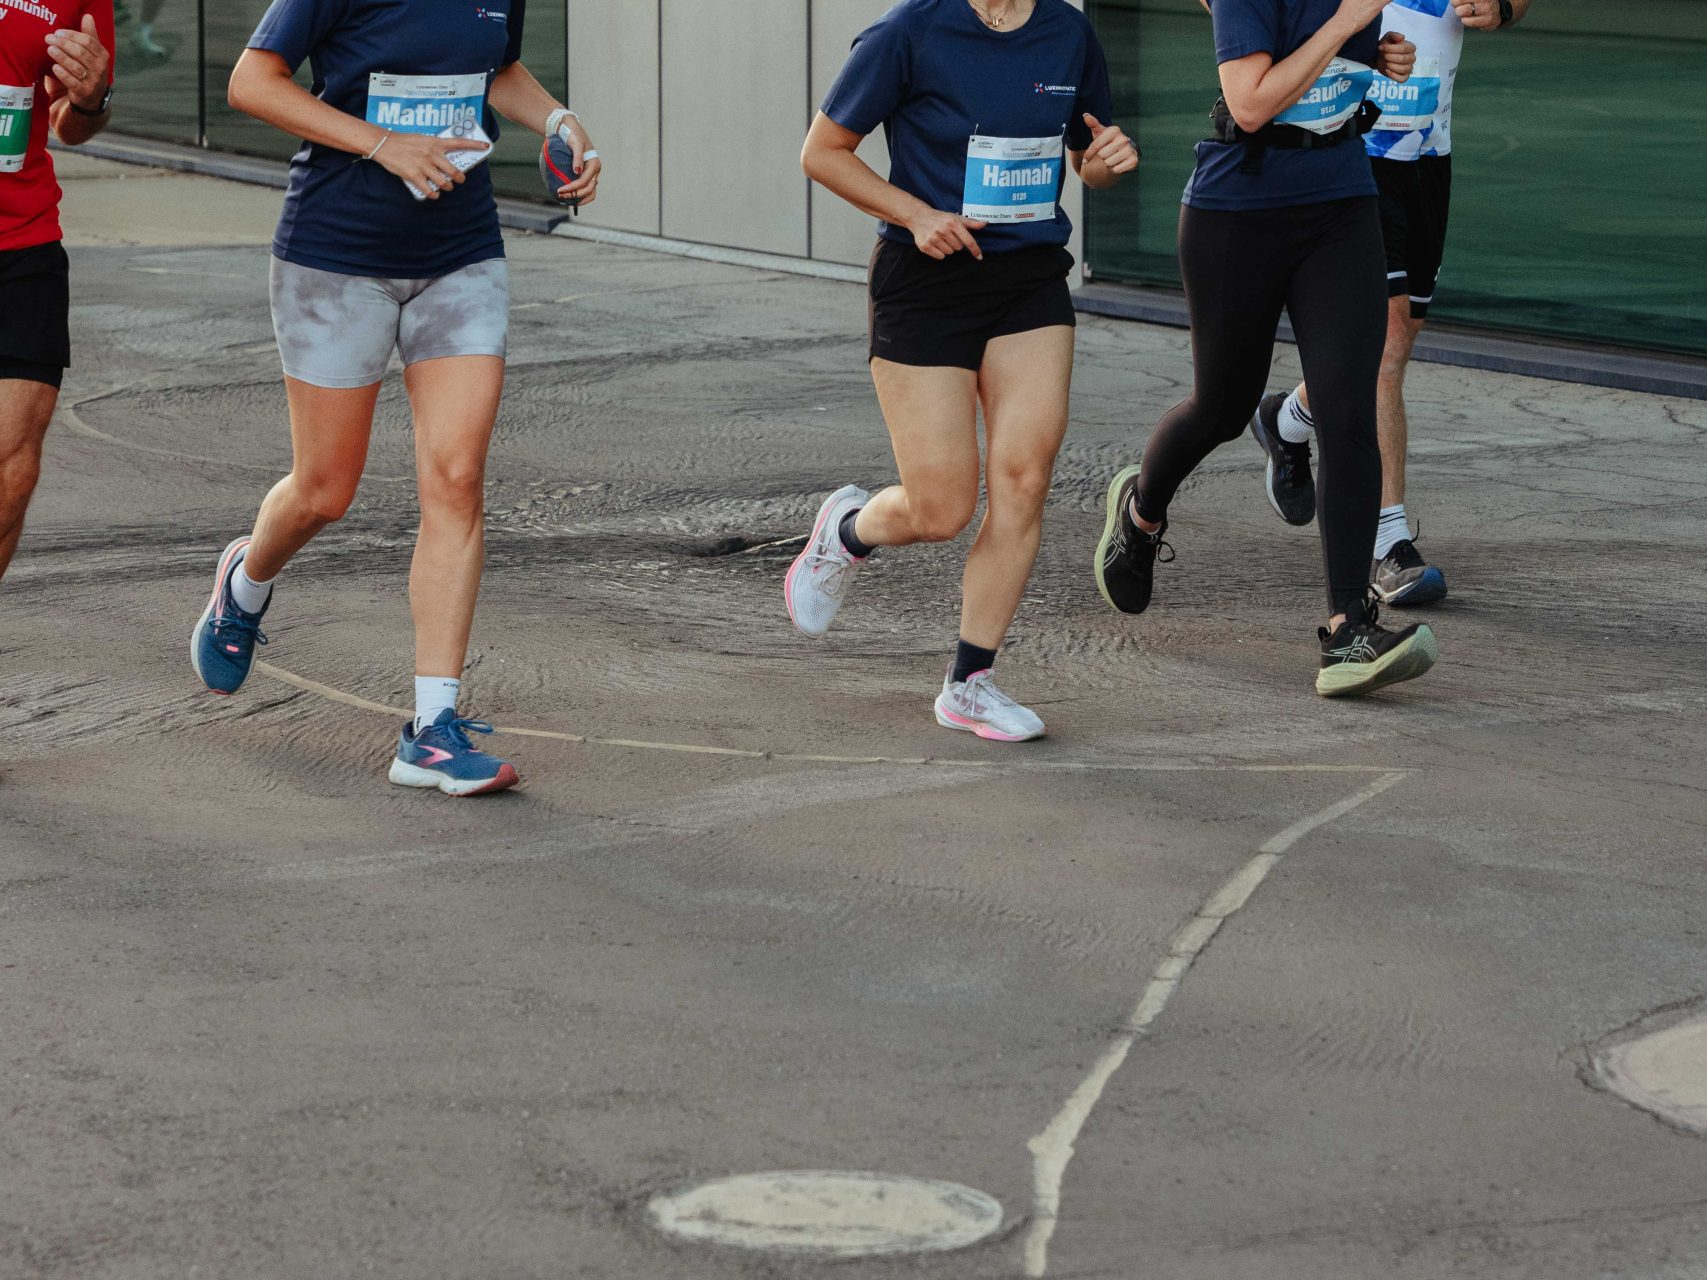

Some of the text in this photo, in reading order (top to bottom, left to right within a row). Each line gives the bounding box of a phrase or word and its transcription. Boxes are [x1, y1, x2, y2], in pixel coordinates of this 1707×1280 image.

[1366, 80, 1419, 103] Björn
[376, 101, 476, 127] Mathilde
[982, 164, 1052, 187] Hannah
